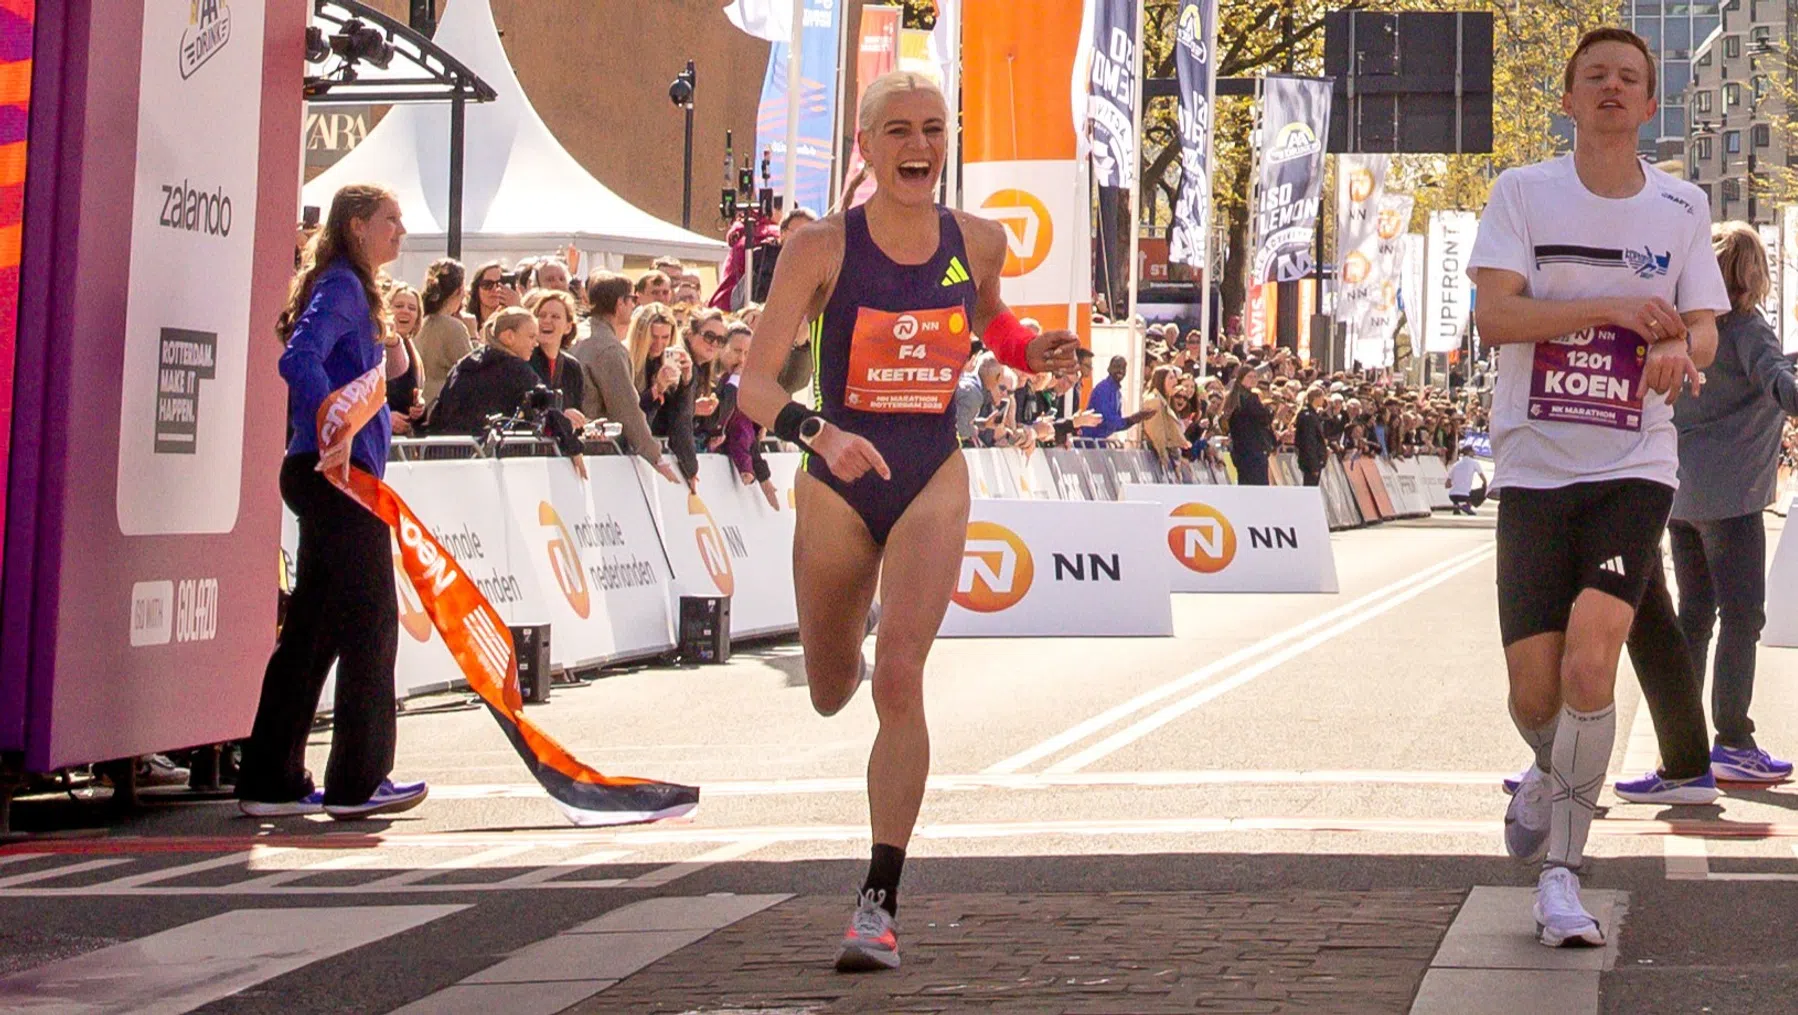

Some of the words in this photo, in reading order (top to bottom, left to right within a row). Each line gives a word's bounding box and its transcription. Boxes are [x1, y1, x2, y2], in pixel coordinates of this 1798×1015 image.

[160, 178, 232, 238] zalando
[1260, 182, 1293, 213] ISO
[1259, 196, 1321, 236] LEMON
[1439, 224, 1461, 338] UPFRONT
[921, 321, 940, 331] NN
[1598, 329, 1616, 341] NN
[898, 343, 927, 360] F4
[1566, 350, 1612, 372] 1201
[160, 369, 185, 394] MAKE
[186, 370, 197, 395] IT
[866, 367, 953, 382] KEETELS
[1544, 370, 1630, 402] KOEN
[891, 395, 938, 403] MARATHON
[1564, 406, 1616, 420] MARATHON
[574, 513, 626, 549] nationale
[722, 525, 748, 559] NN
[1247, 526, 1299, 550] NN
[589, 552, 658, 592] nederlanden
[1053, 552, 1122, 582] NN
[177, 577, 218, 642] GOLAZO
